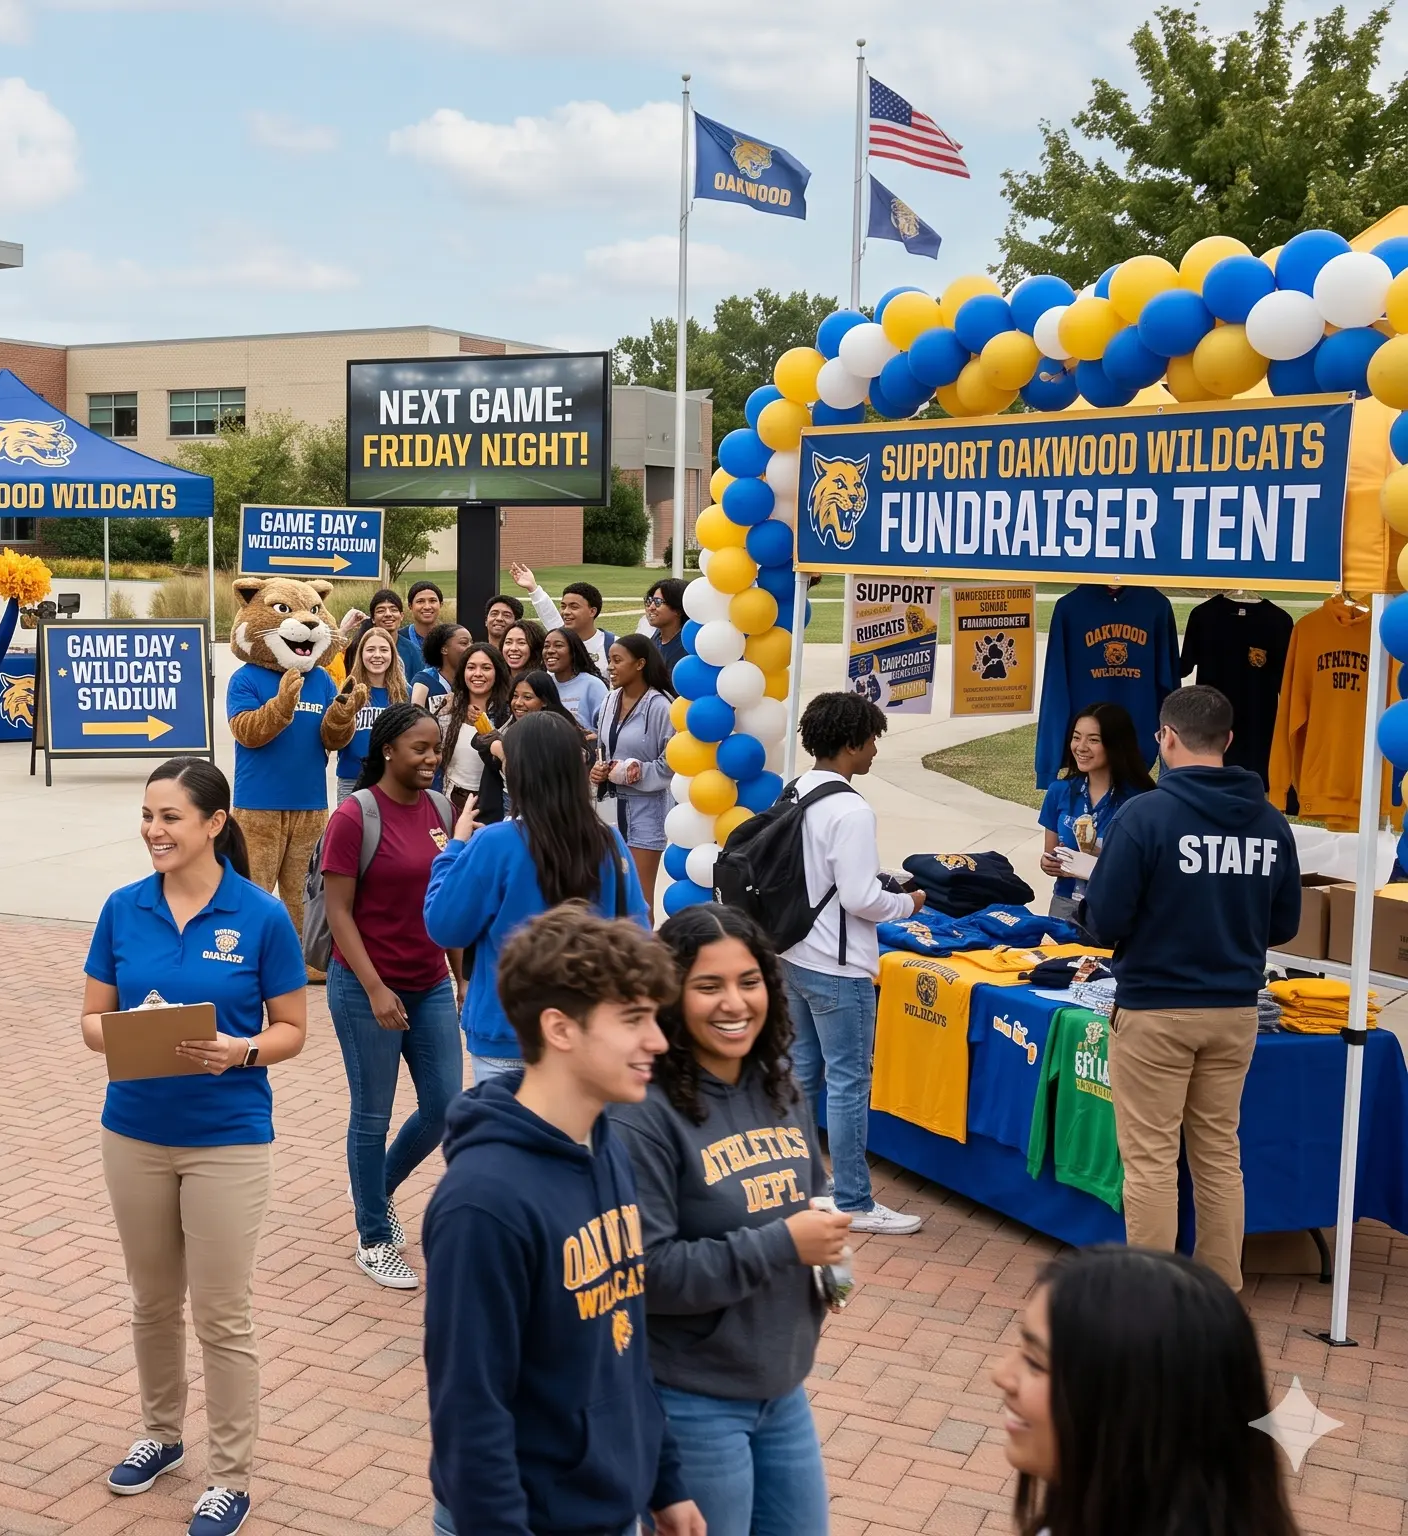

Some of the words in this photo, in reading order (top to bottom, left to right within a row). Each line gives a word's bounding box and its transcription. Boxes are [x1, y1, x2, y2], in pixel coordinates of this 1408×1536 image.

[714, 172, 791, 207] OAKWOOD
[379, 389, 461, 425] NEXT
[470, 386, 572, 423] GAME:
[363, 434, 472, 467] FRIDAY
[481, 432, 588, 466] NIGHT!
[881, 439, 992, 481] SUPPORT
[998, 431, 1136, 478] OAKWOOD
[1146, 422, 1325, 475] WILDCATS
[51, 483, 177, 510] WILDCATS
[260, 512, 316, 534] GAME
[320, 514, 356, 535] DAY
[880, 487, 1158, 560] FUNDRAISER
[1173, 484, 1321, 562] TENT
[248, 534, 314, 551] WILDCATS
[316, 536, 376, 553] STADIUM
[856, 582, 936, 605] SUPPORT
[67, 634, 128, 658] GAME
[135, 634, 175, 658] DAY
[1085, 623, 1147, 647] OAKWOOD
[72, 661, 181, 684] WILDCATS
[77, 687, 177, 711] STADIUM
[1178, 834, 1278, 877] STAFF
[740, 1168, 806, 1214] DEPT.
